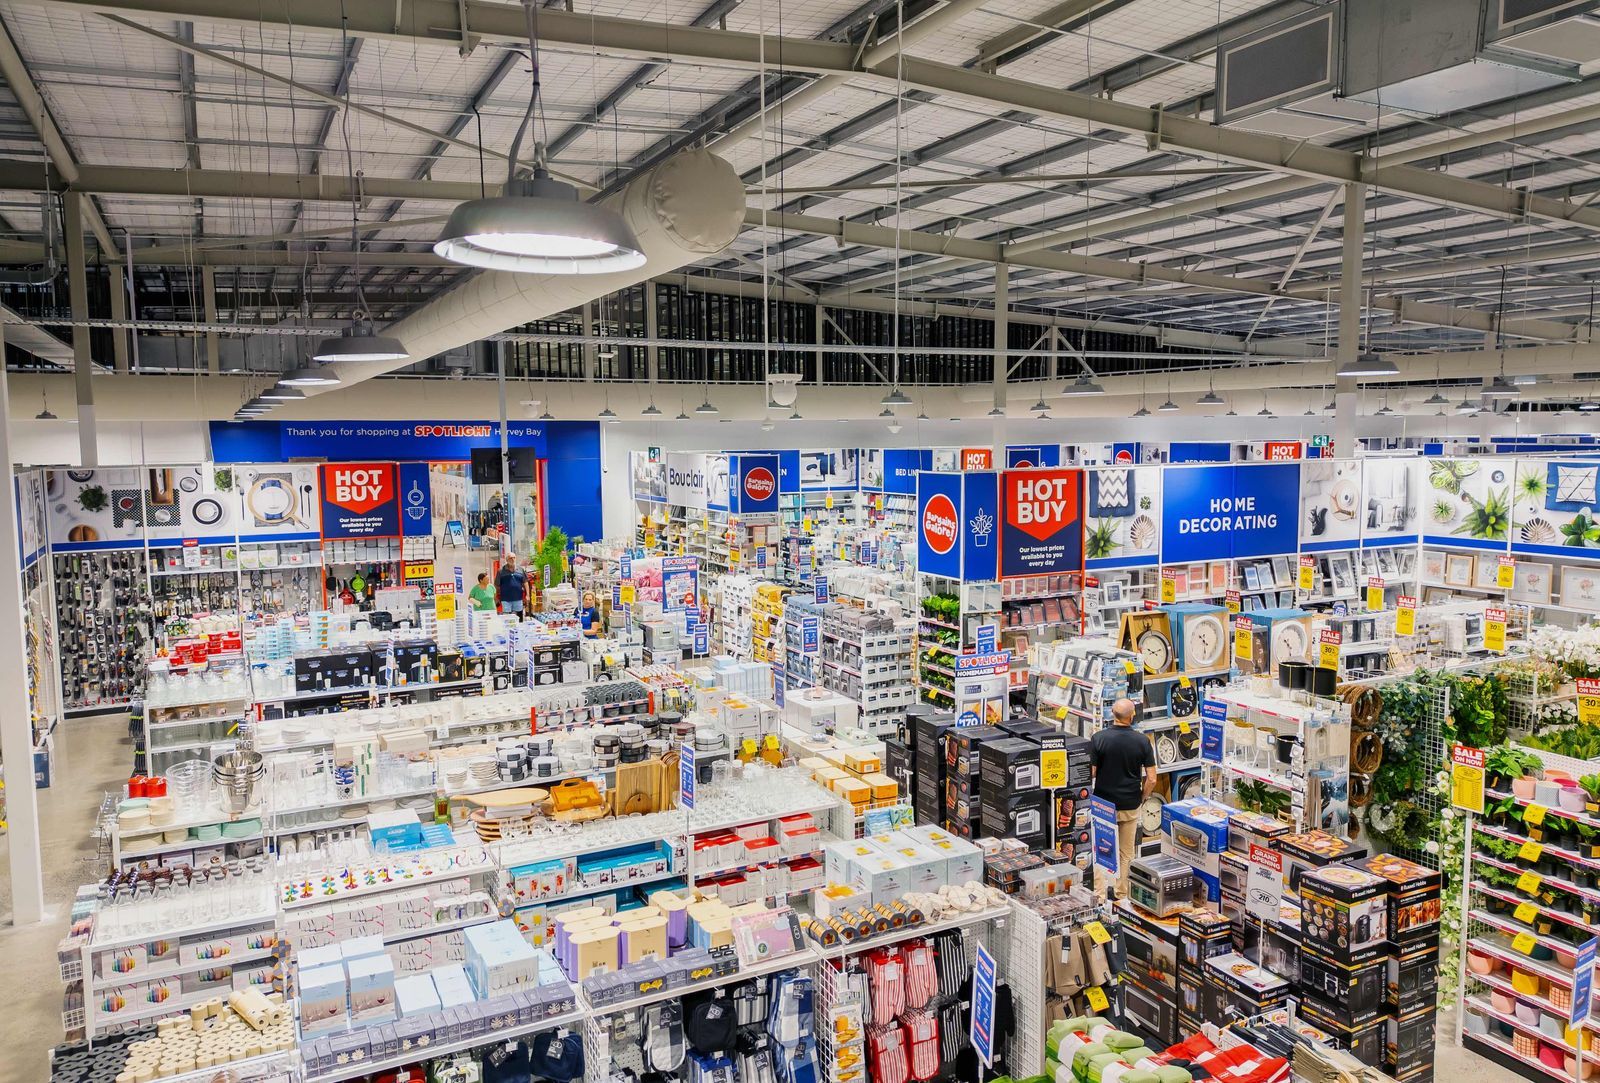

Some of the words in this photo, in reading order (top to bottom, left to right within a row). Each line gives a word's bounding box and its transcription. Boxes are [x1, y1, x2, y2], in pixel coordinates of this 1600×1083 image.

[286, 428, 316, 436] Thank
[320, 430, 337, 438] you
[340, 428, 353, 436] for
[356, 427, 400, 438] shopping
[402, 428, 411, 436] at
[414, 425, 492, 437] SPOTLIGHT
[494, 428, 524, 437] Hrvey
[526, 428, 542, 437] Bay
[1272, 446, 1295, 455] HOT
[966, 454, 986, 464] HOT
[335, 469, 383, 486] HOT
[669, 467, 705, 488] Bouclair
[336, 485, 383, 502] BUY
[1017, 479, 1067, 502] HOT
[1017, 500, 1067, 524] BUY
[1210, 496, 1256, 514] HOME
[927, 512, 956, 529] Bargains
[1179, 514, 1278, 534] DECORATING
[926, 520, 955, 541] Galore!
[1048, 545, 1065, 553] prices
[1322, 631, 1340, 639] SALE
[959, 654, 1008, 668] SPOTLIGHT
[957, 667, 994, 677] HOMEMAKER
[995, 666, 1008, 674] SALE
[1578, 680, 1600, 688] SAL
[1454, 747, 1482, 760] SALE
[1466, 758, 1482, 766] NOW
[1176, 850, 1190, 860] Russell
[1191, 857, 1206, 867] Hobbs
[1252, 854, 1280, 870] OPENING
[1254, 850, 1277, 862] GRAND
[1306, 879, 1320, 888] Russell
[1321, 885, 1334, 893] Hobbs
[1259, 894, 1270, 903] 210
[1210, 965, 1225, 977] Russell
[1225, 977, 1240, 988] Hobbs
